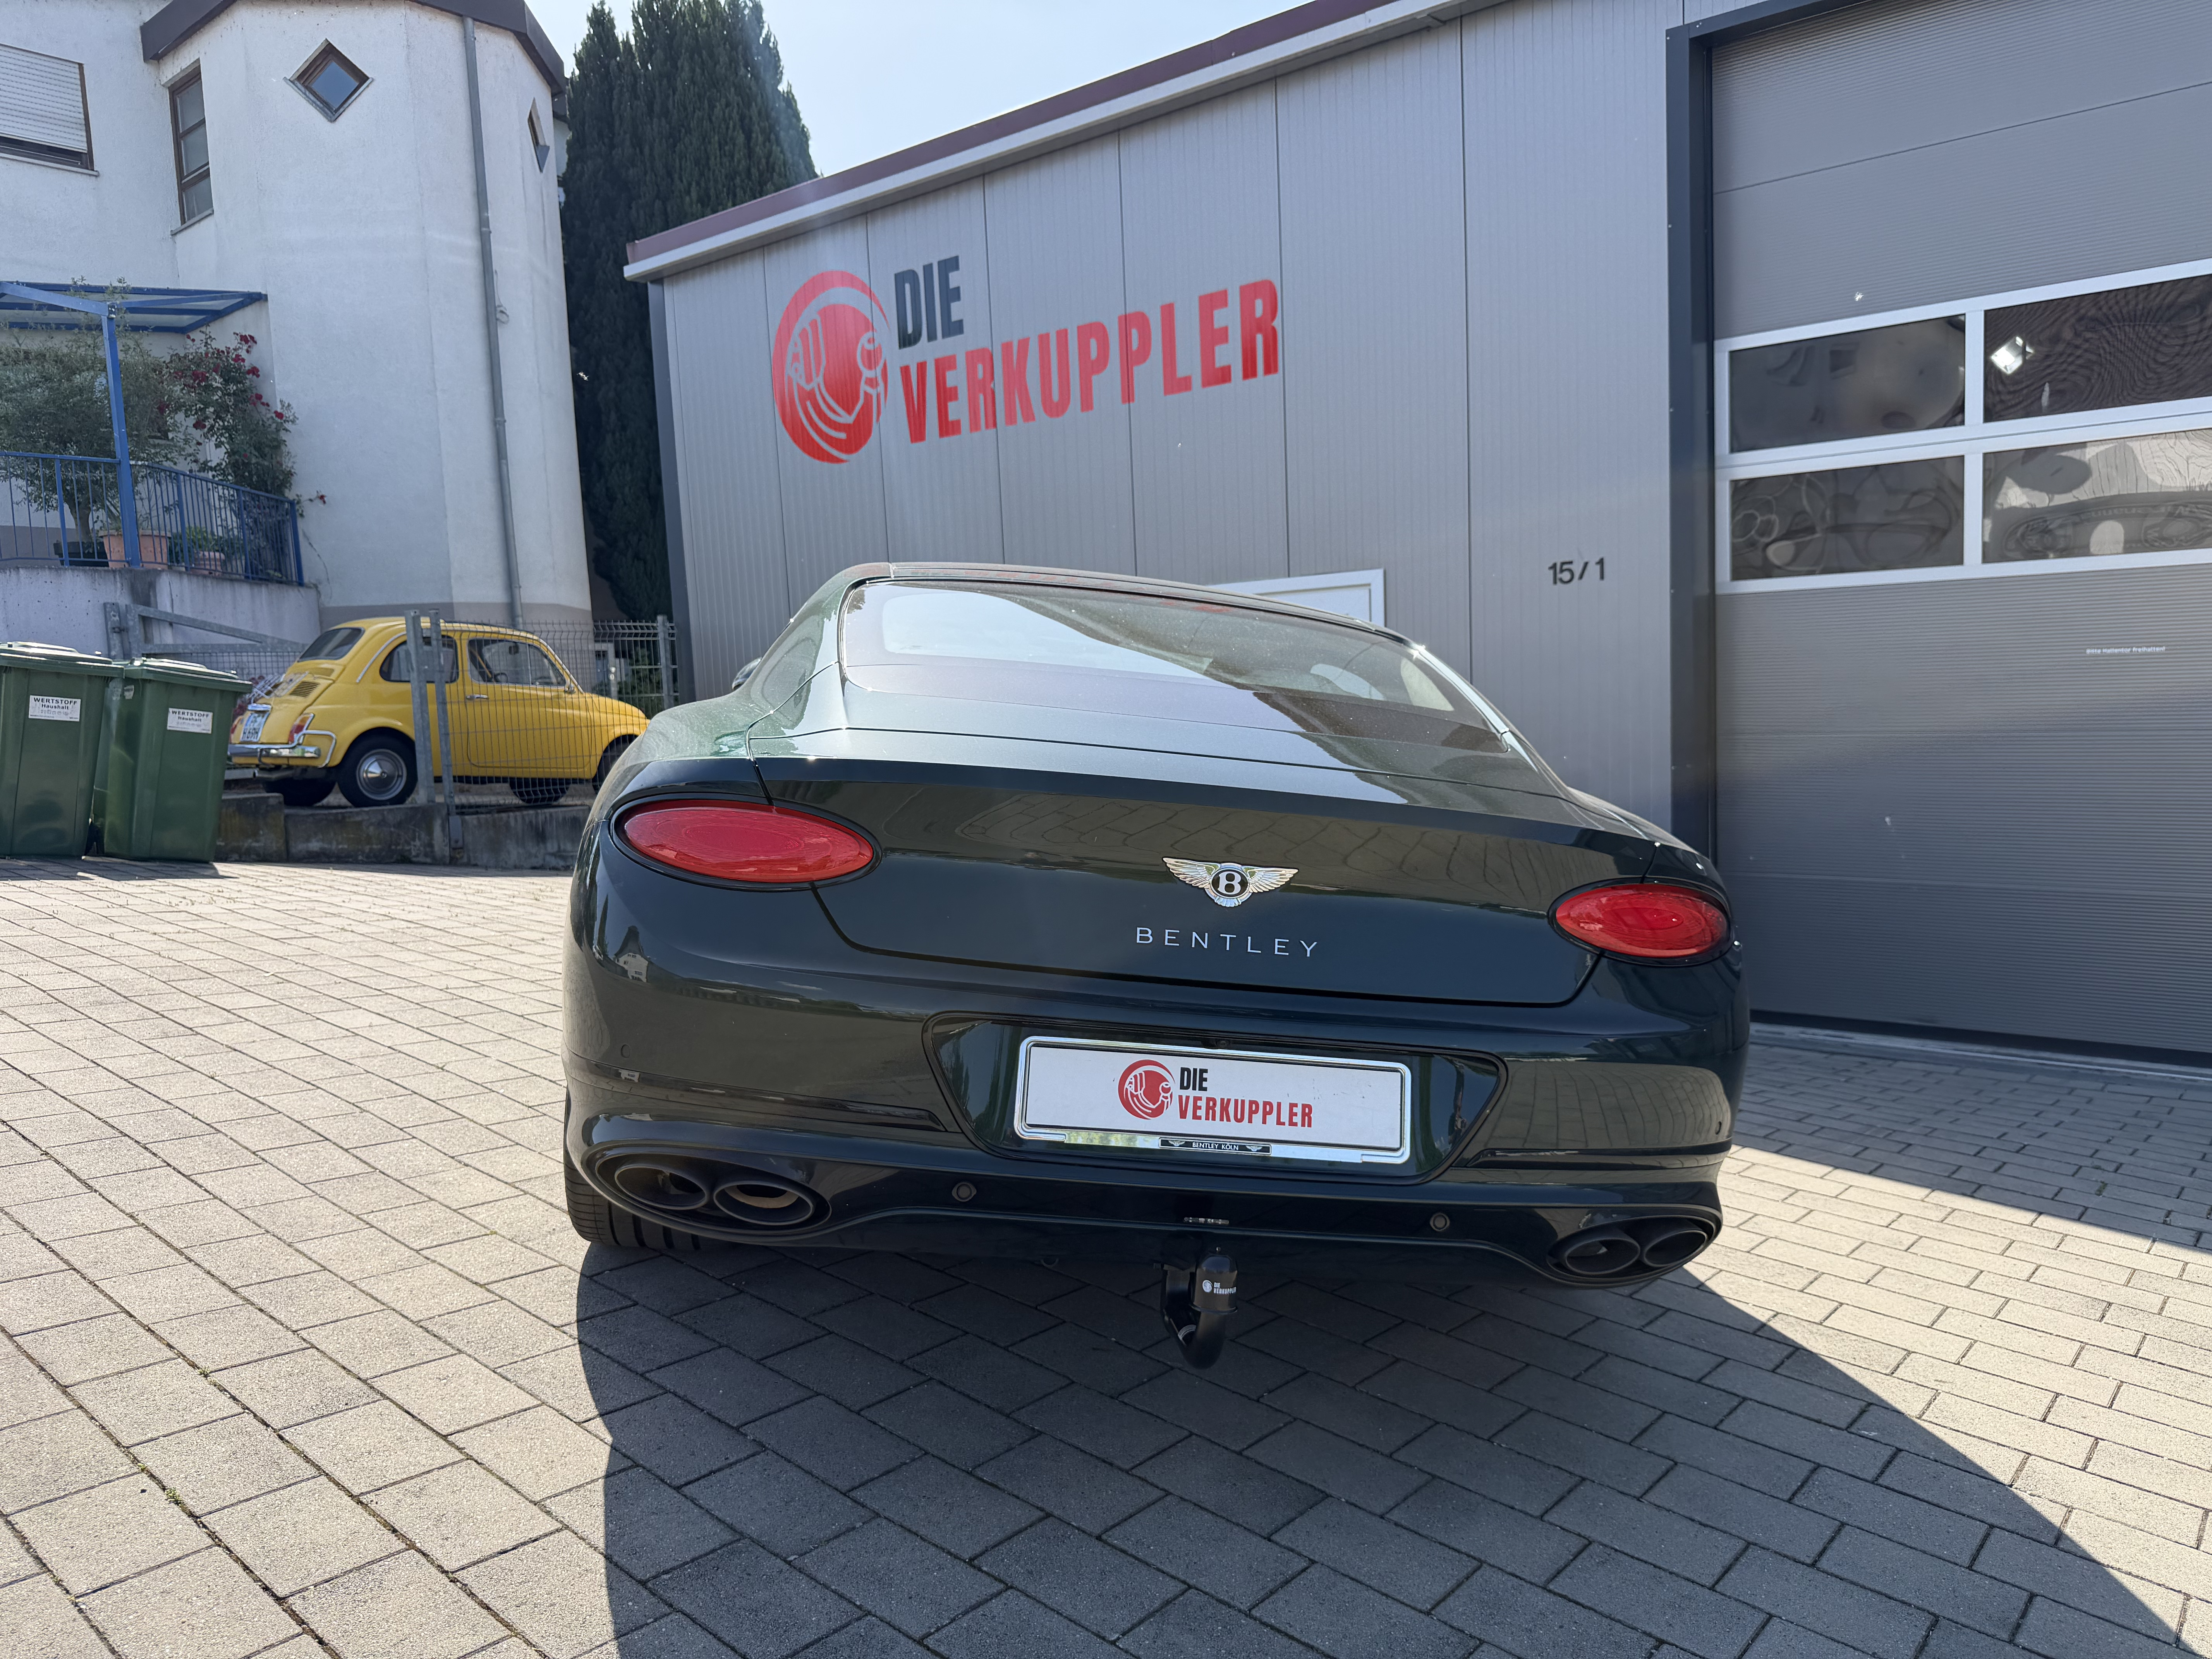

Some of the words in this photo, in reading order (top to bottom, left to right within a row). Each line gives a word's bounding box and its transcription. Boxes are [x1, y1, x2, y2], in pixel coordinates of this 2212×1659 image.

[894, 255, 964, 349] DIE
[900, 279, 1279, 444] VERKUPPLER
[1217, 871, 1242, 894] B
[1137, 927, 1317, 957] BENTLEY
[1180, 1067, 1208, 1092] DIE
[1178, 1095, 1313, 1128] VERKUPPLER
